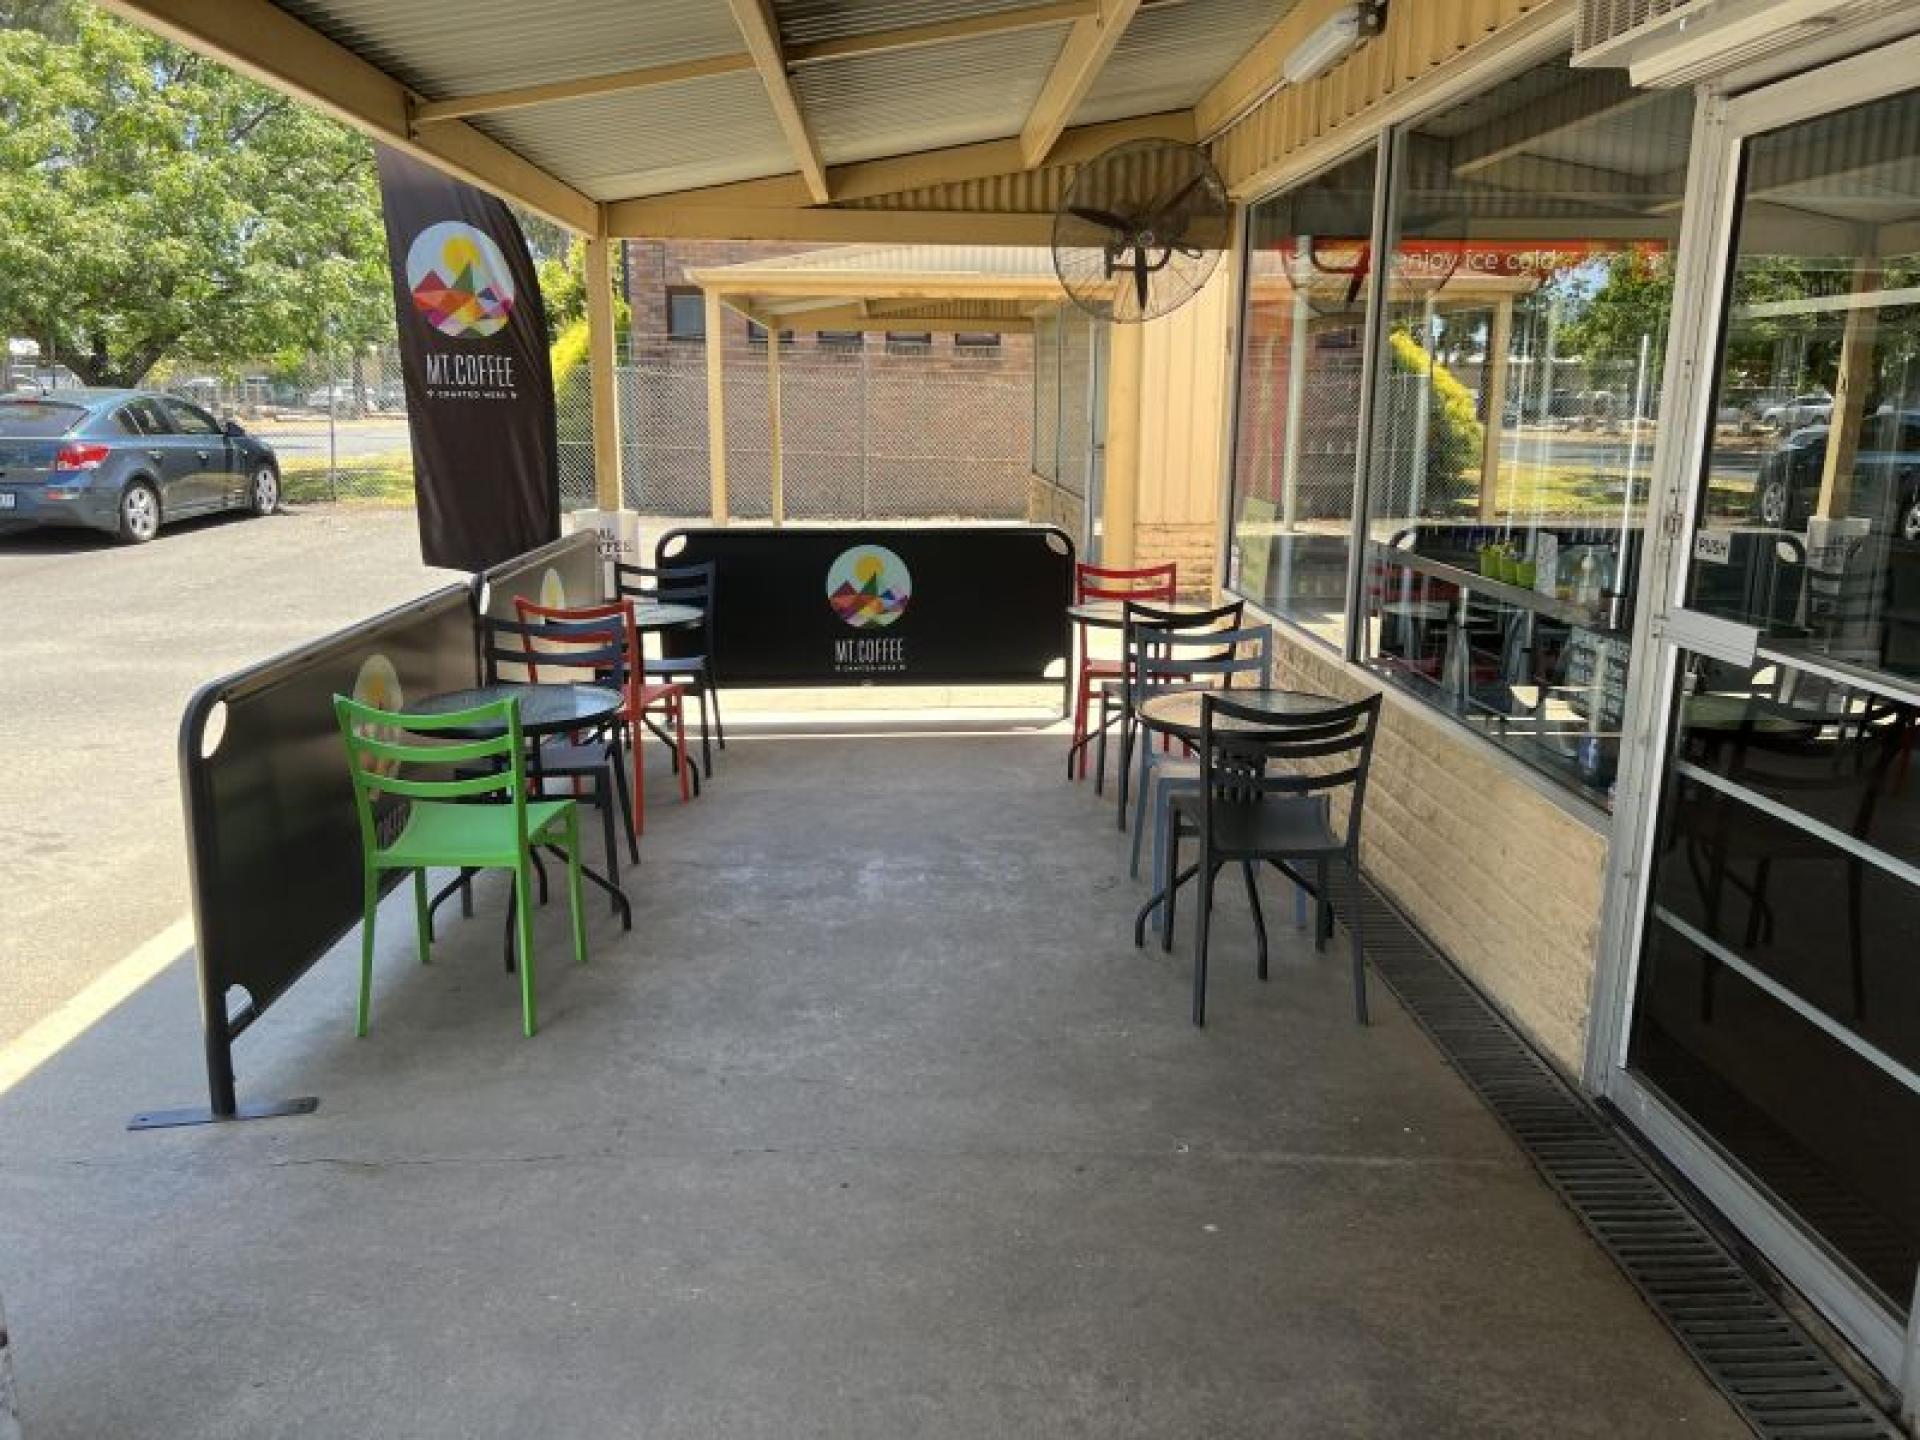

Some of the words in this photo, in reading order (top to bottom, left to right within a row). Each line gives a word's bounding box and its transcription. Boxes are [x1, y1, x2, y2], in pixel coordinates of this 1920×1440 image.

[1465, 249, 1498, 270] ice
[1506, 248, 1556, 271] cold
[426, 353, 515, 387] MT.COFFEE
[834, 639, 904, 663] MT.COFFEE
